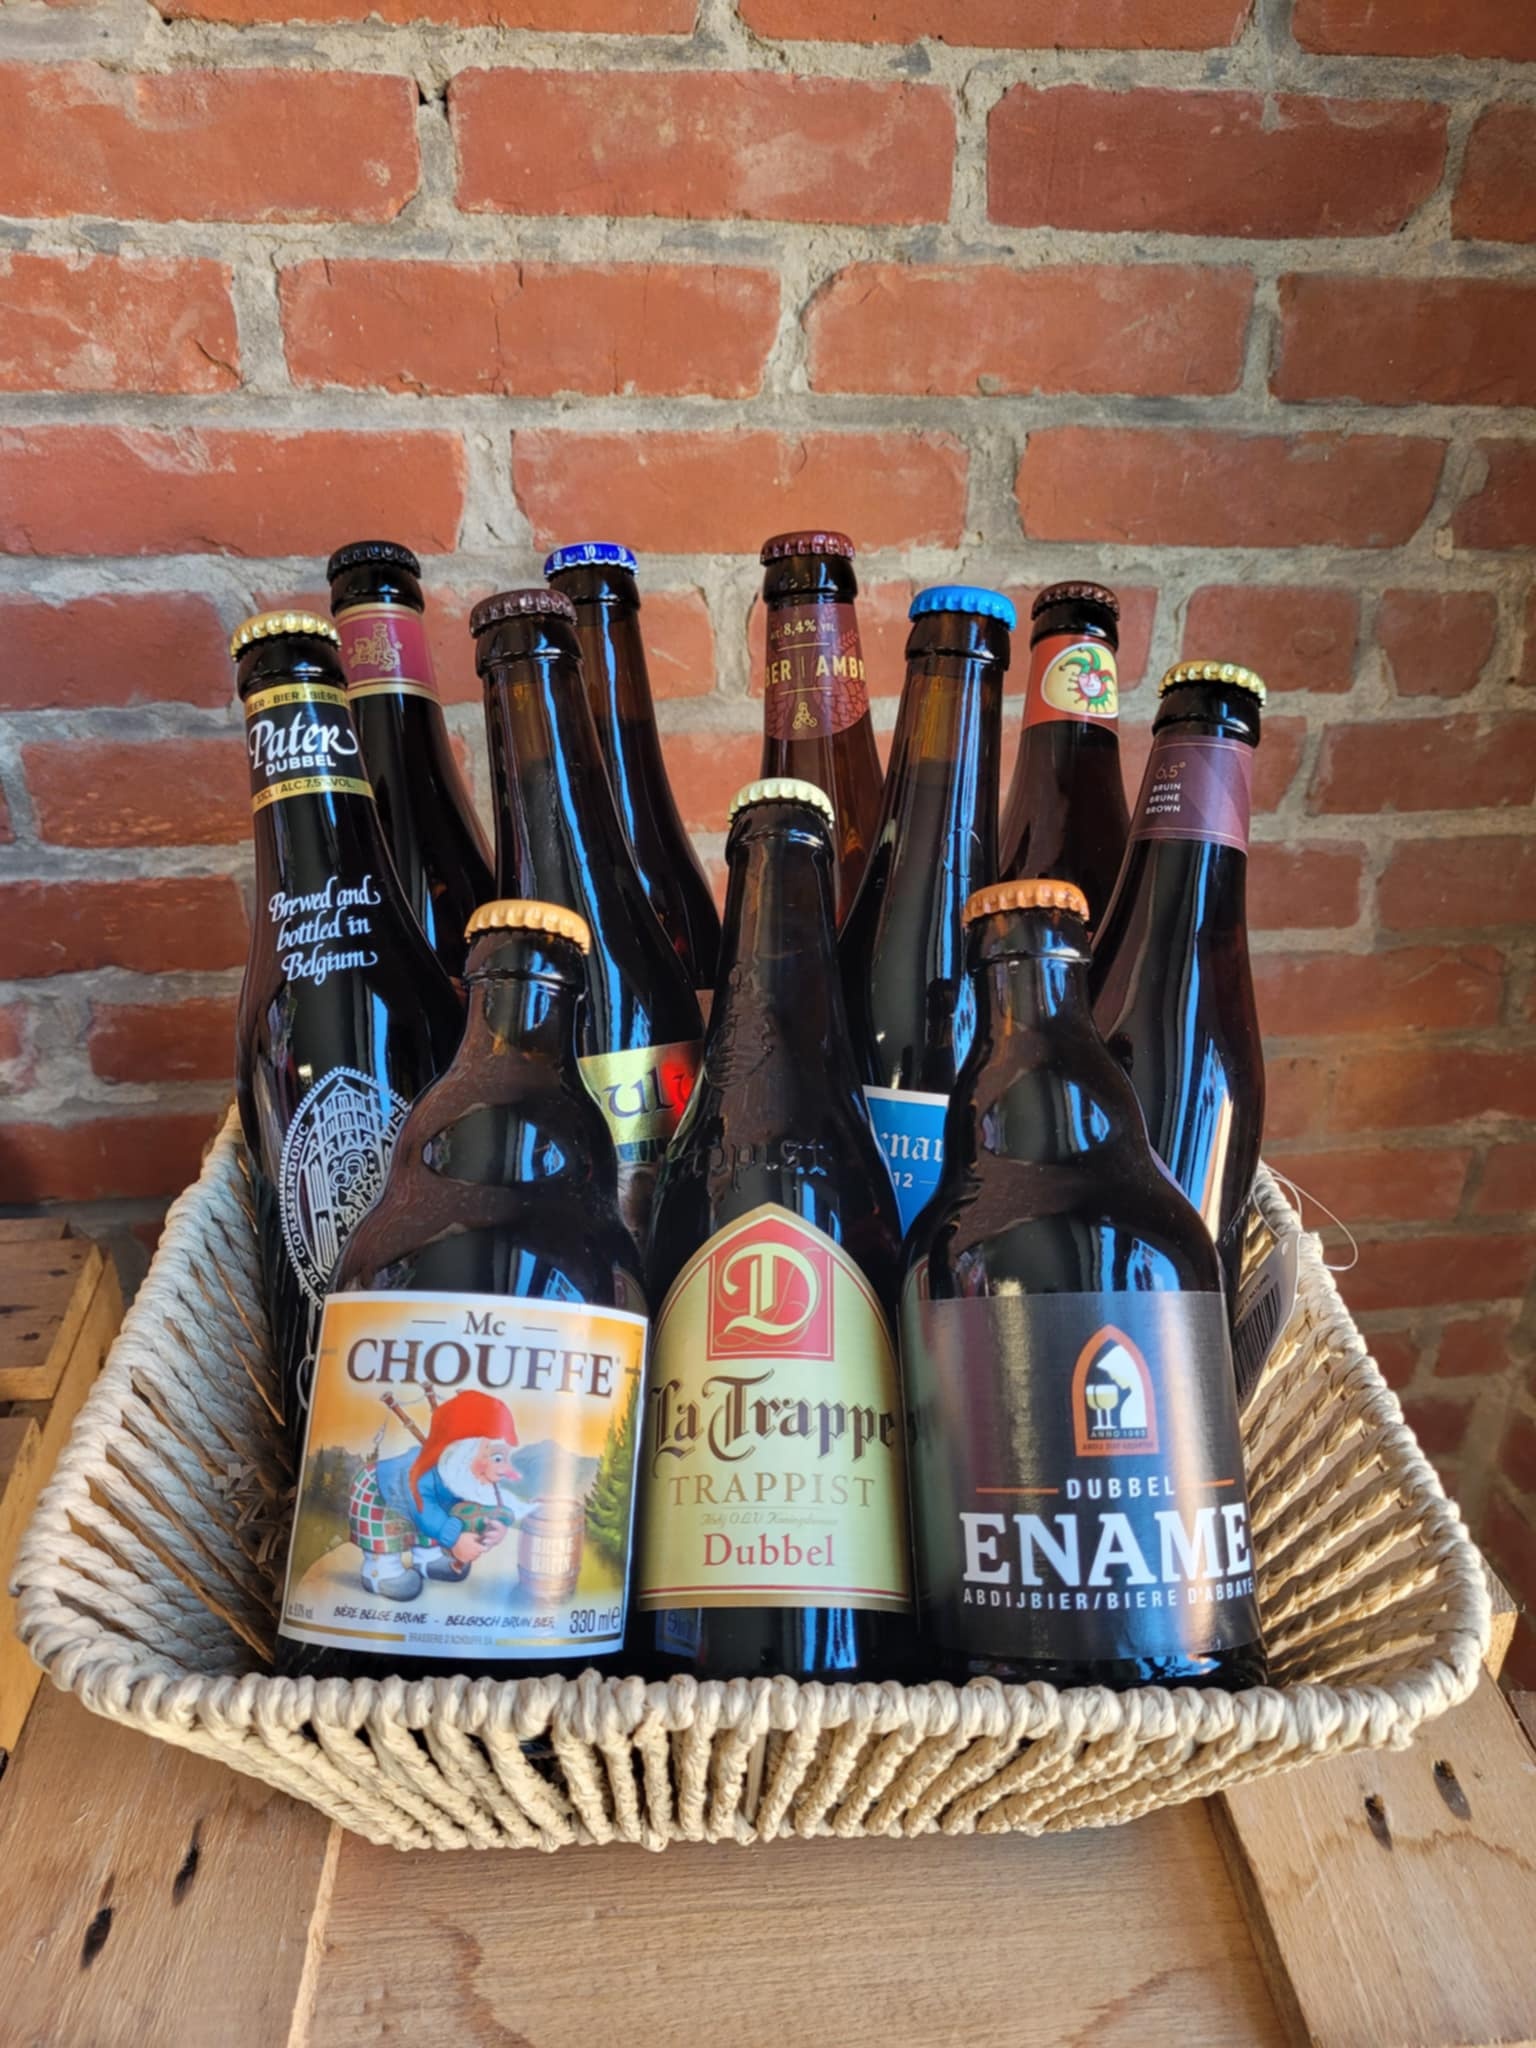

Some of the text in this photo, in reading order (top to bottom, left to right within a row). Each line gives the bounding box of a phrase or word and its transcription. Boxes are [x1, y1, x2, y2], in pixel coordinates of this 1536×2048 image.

[265, 754, 337, 777] DUBBEL
[1149, 793, 1180, 804] BRUNE
[1152, 783, 1181, 793] BRUIN
[1145, 804, 1181, 815] BROWN
[268, 874, 382, 923] Brewed and
[276, 906, 373, 953] bottled in
[281, 943, 378, 987] Belgium
[463, 1310, 506, 1338] Mc
[347, 1338, 613, 1398] CHOUFFE
[649, 1368, 896, 1479] La Trappe
[669, 1472, 876, 1508] TRAPPIST
[1066, 1475, 1176, 1500] DUBBEL
[702, 1533, 836, 1568] Dubbel
[958, 1501, 1252, 1588] ENAME
[393, 1611, 428, 1625] BRUNE
[445, 1614, 499, 1627] BELGISCH
[569, 1609, 597, 1634] 330
